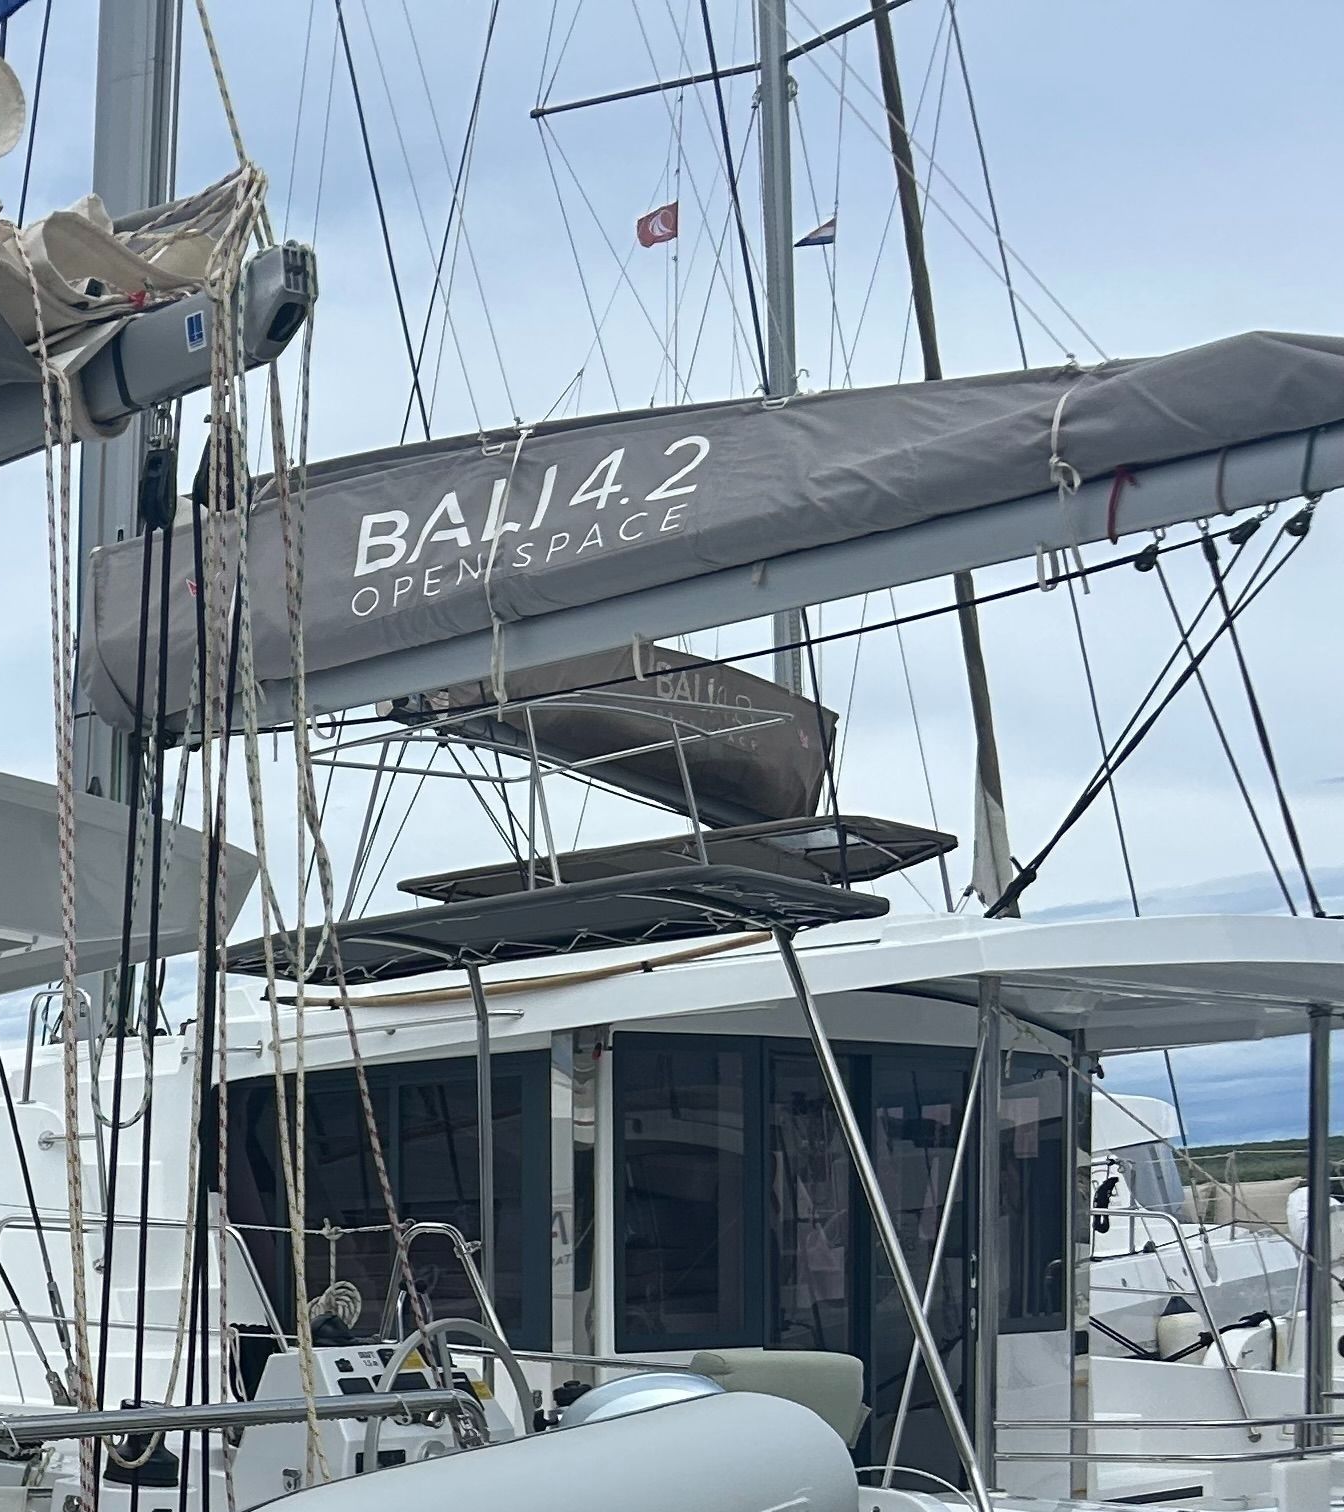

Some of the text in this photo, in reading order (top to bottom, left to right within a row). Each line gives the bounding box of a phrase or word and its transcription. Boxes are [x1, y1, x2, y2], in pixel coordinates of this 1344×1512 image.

[350, 503, 688, 617] OPEN SPACE
[354, 435, 710, 577] BALI 4.2
